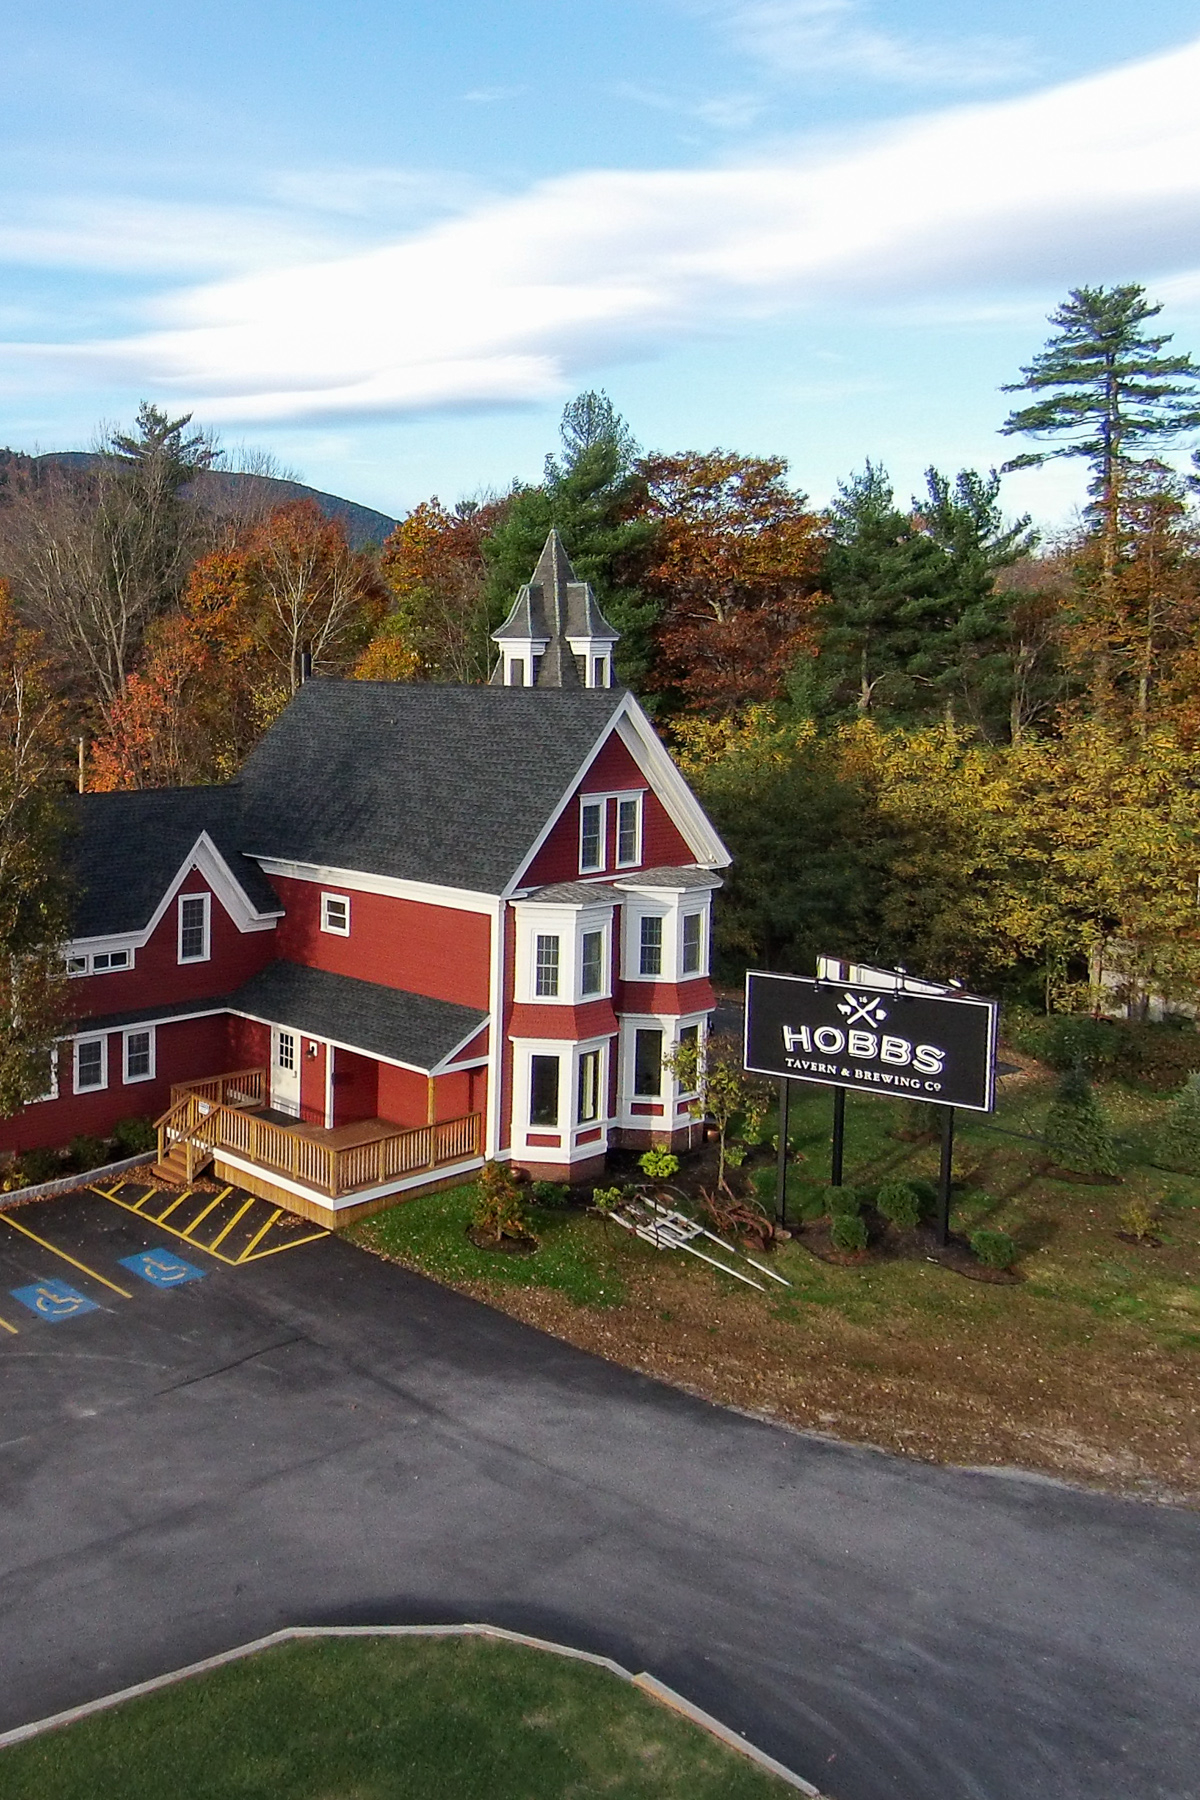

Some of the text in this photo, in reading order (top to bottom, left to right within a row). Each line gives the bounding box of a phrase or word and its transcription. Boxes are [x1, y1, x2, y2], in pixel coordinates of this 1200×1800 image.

[783, 1025, 946, 1075] HOBBS
[785, 1057, 837, 1075] TAVERN
[840, 1067, 850, 1077] &
[855, 1069, 921, 1089] BREWING
